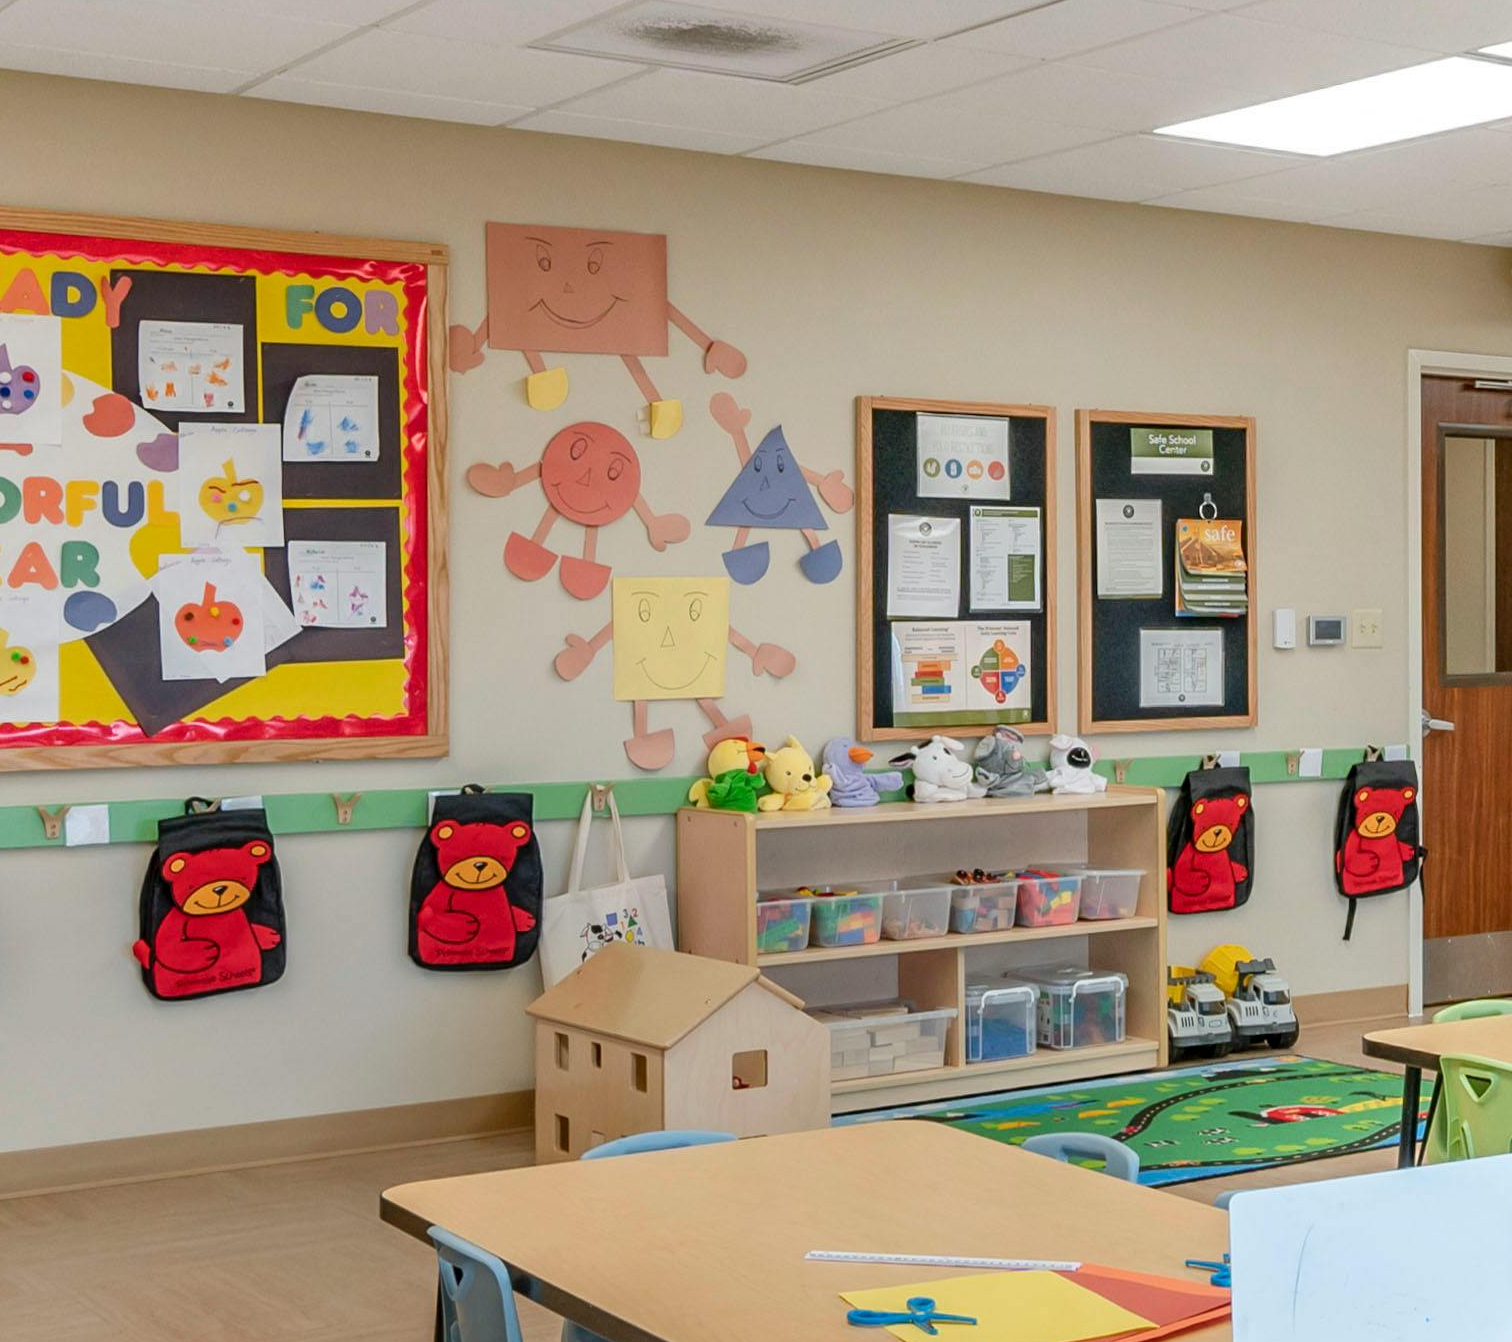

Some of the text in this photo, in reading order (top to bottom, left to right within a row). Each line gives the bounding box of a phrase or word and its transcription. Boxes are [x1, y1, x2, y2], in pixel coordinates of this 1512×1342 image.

[285, 284, 400, 336] FOR
[1148, 434, 1197, 445] Safe School
[1158, 444, 1188, 455] Center
[1204, 525, 1236, 542] safe
